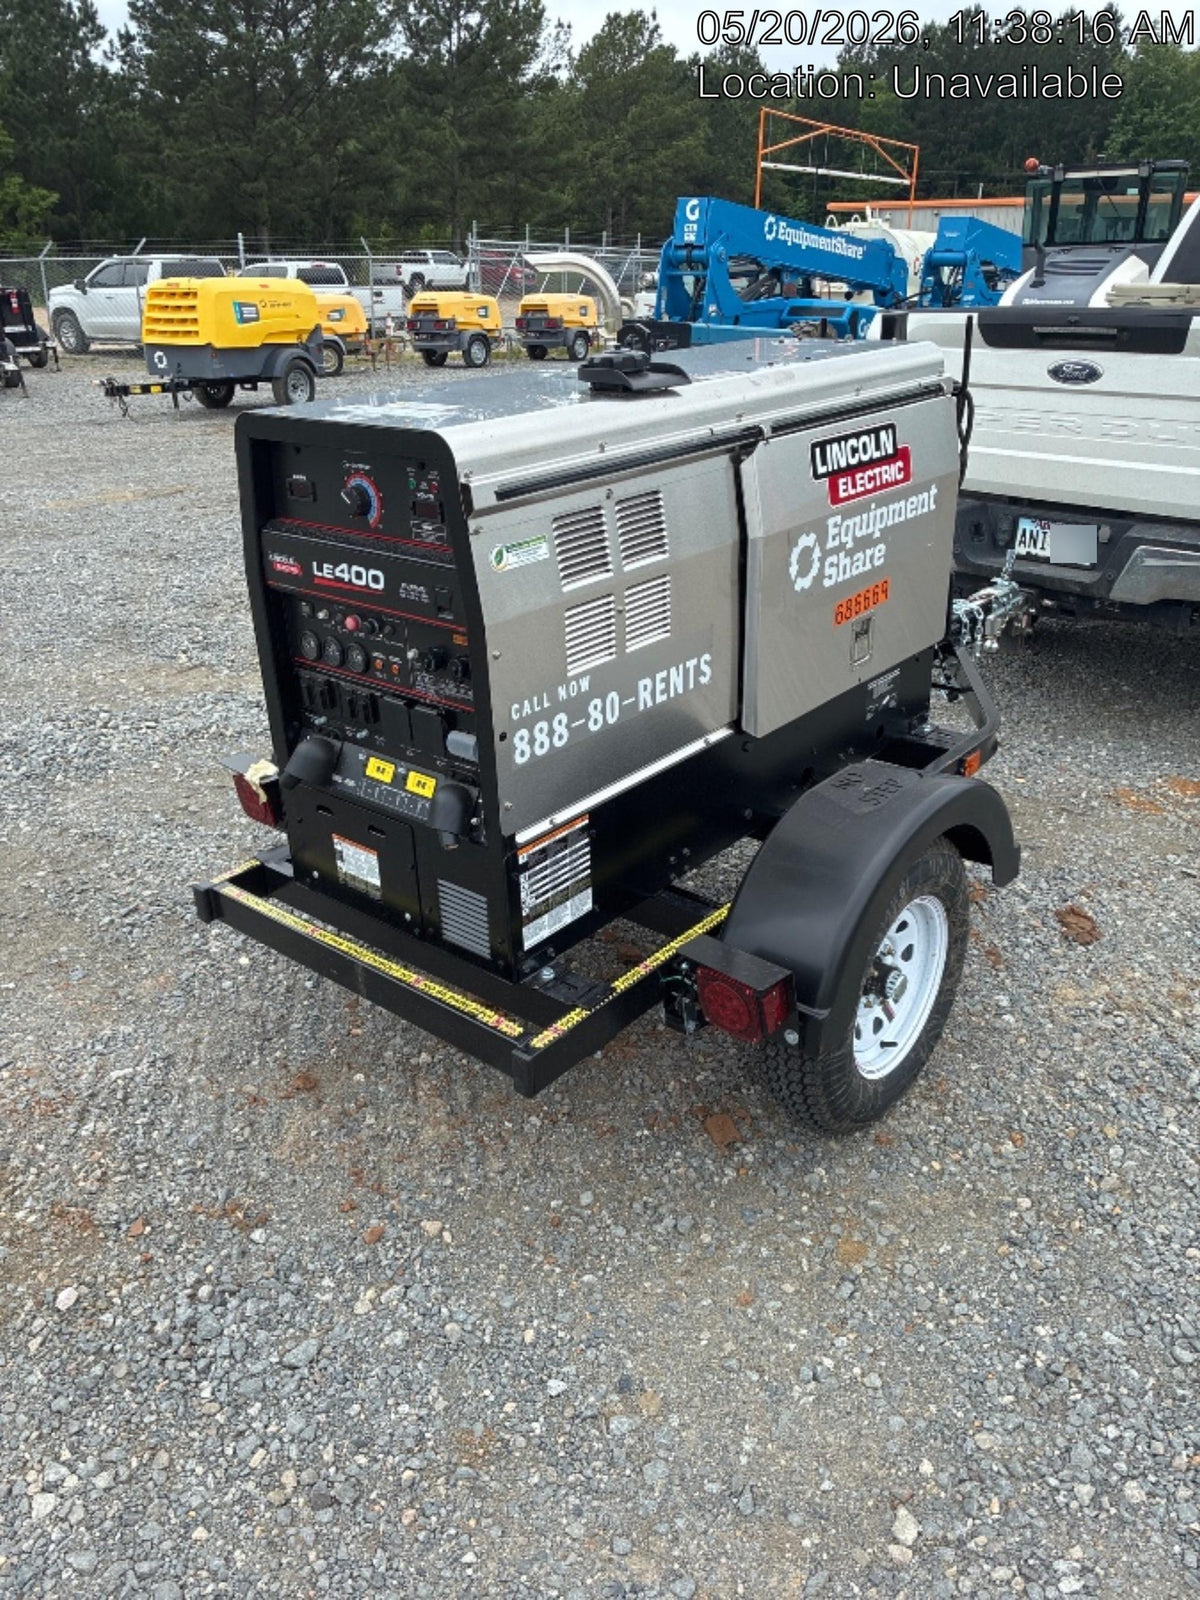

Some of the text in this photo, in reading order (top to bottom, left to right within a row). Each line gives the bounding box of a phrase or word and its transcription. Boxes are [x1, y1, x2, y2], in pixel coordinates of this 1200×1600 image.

[778, 221, 864, 260] EquipmentShare
[814, 427, 894, 476] LINCOLN
[837, 460, 905, 499] ELECTRIC
[825, 483, 938, 550] Equipment
[312, 560, 385, 591] LE400
[822, 542, 887, 588] Share
[511, 675, 591, 721] CALL NOW
[512, 653, 712, 765] 888-80-RENTS
